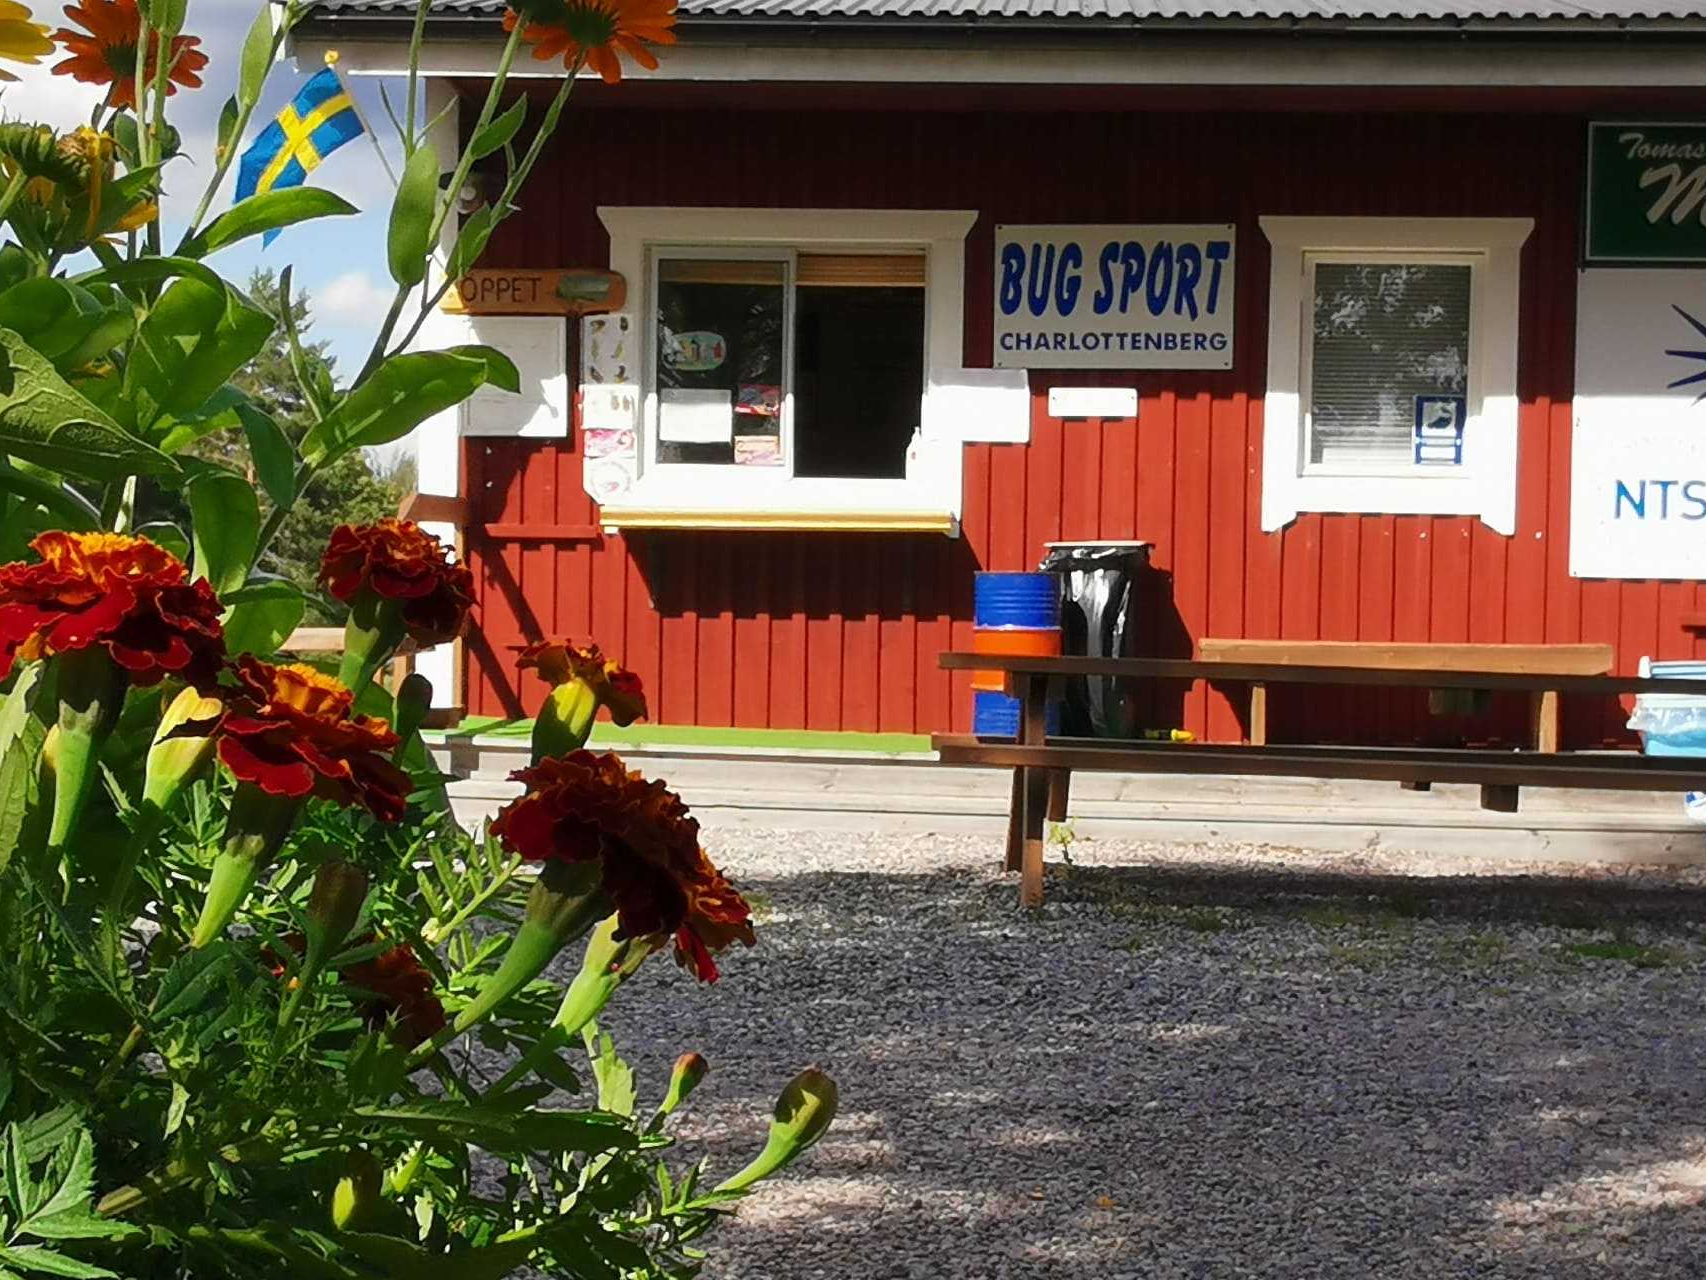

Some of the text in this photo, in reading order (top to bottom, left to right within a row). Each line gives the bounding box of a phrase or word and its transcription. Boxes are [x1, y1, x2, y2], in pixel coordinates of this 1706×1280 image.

[1619, 133, 1706, 160] Tomas
[1000, 240, 1231, 322] BUG SPORT
[1000, 332, 1227, 351] CHARLOTTENBERG
